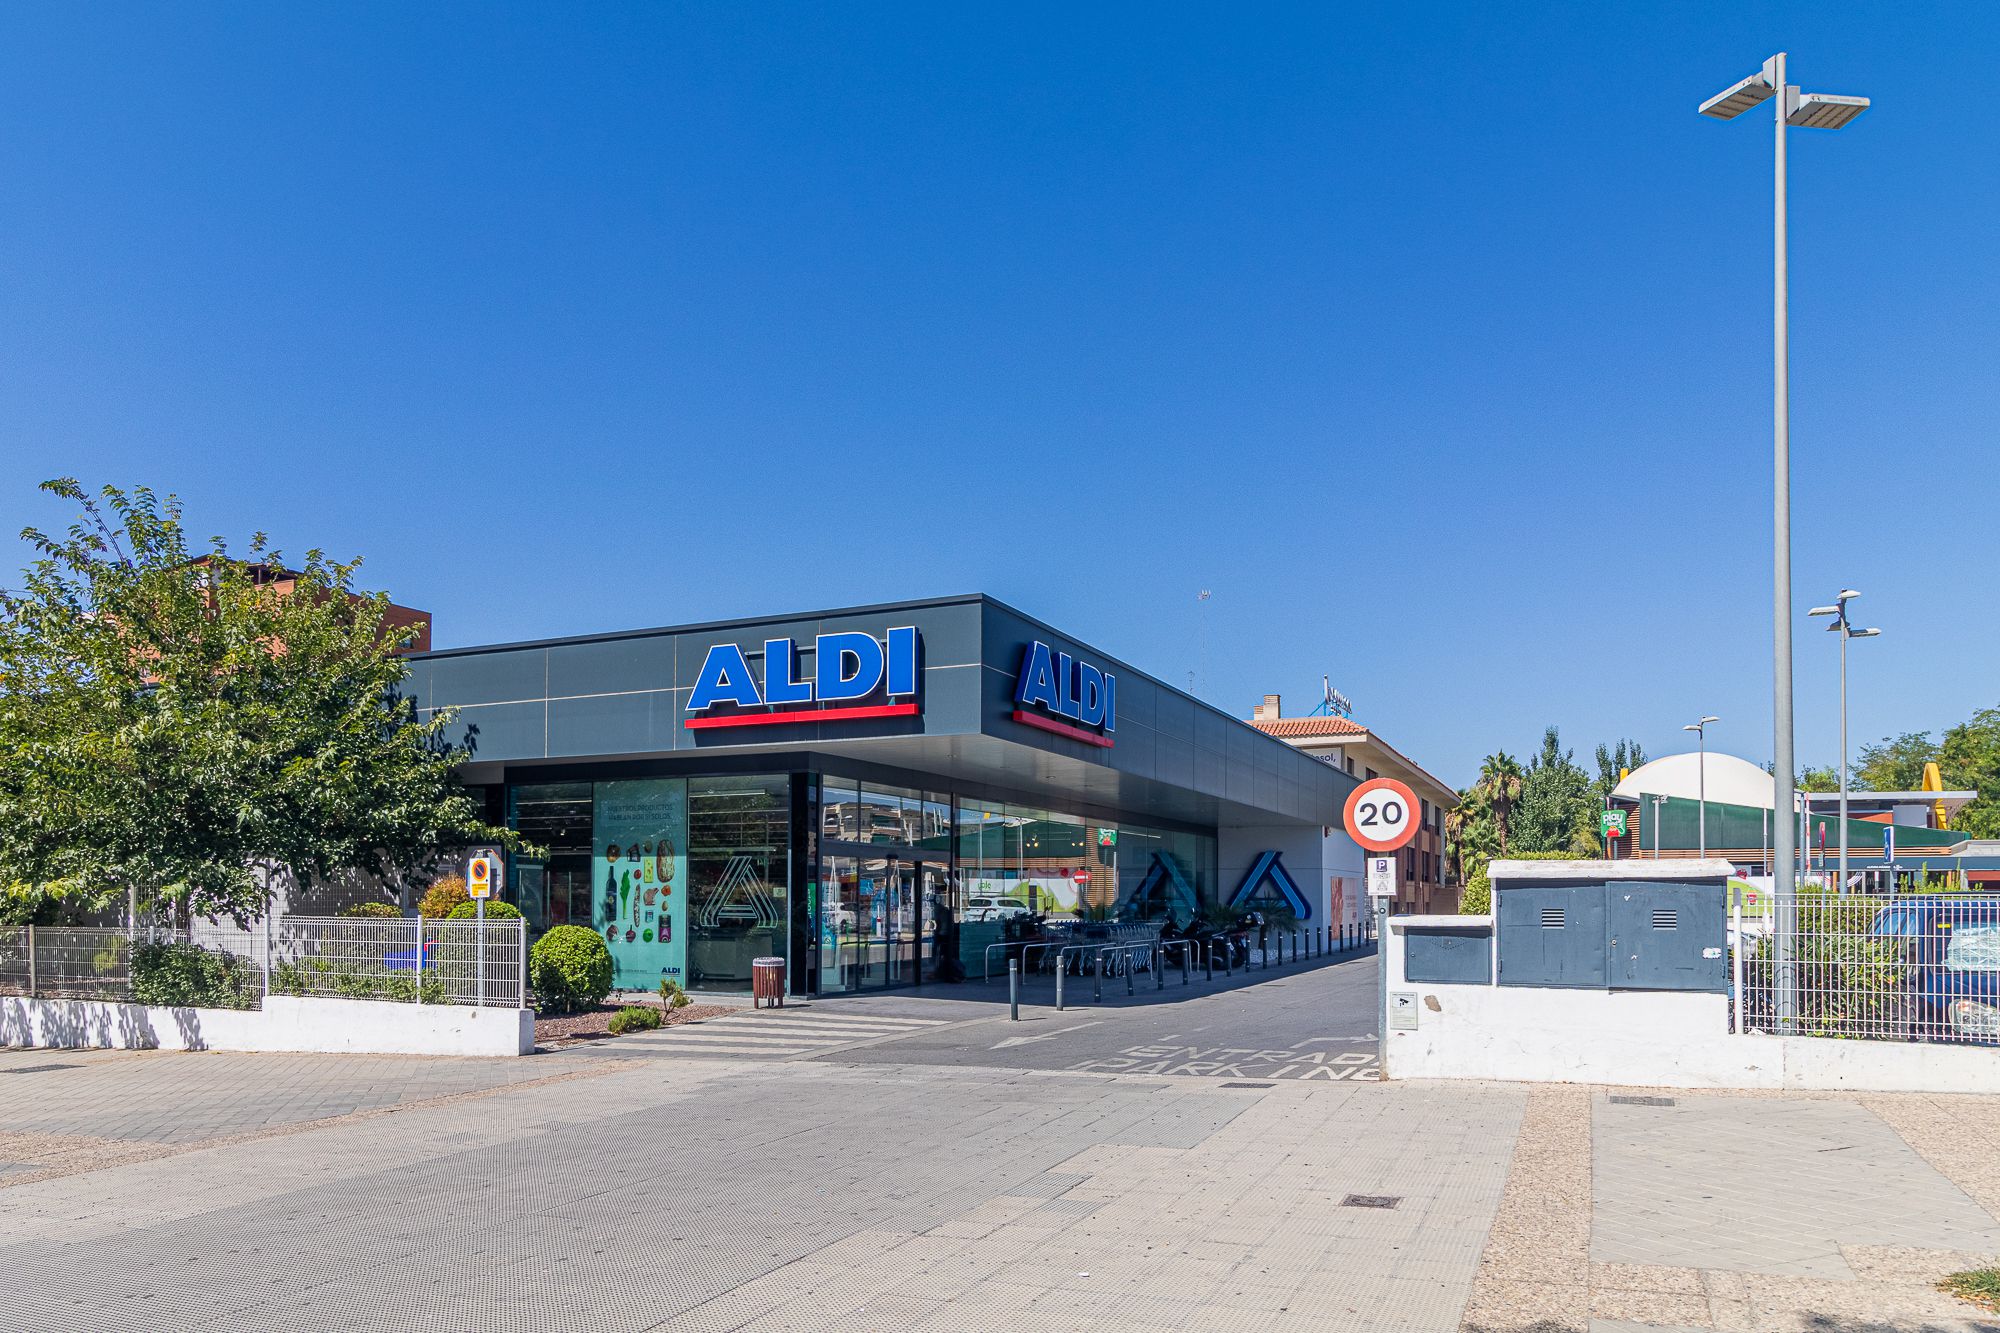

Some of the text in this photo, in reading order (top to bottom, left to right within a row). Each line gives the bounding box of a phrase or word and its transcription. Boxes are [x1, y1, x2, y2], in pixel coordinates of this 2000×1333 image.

[685, 626, 919, 711] ALDI
[1017, 640, 1115, 732] ALDI
[1359, 801, 1403, 827] 20
[1119, 1045, 1379, 1066] ENTRAD
